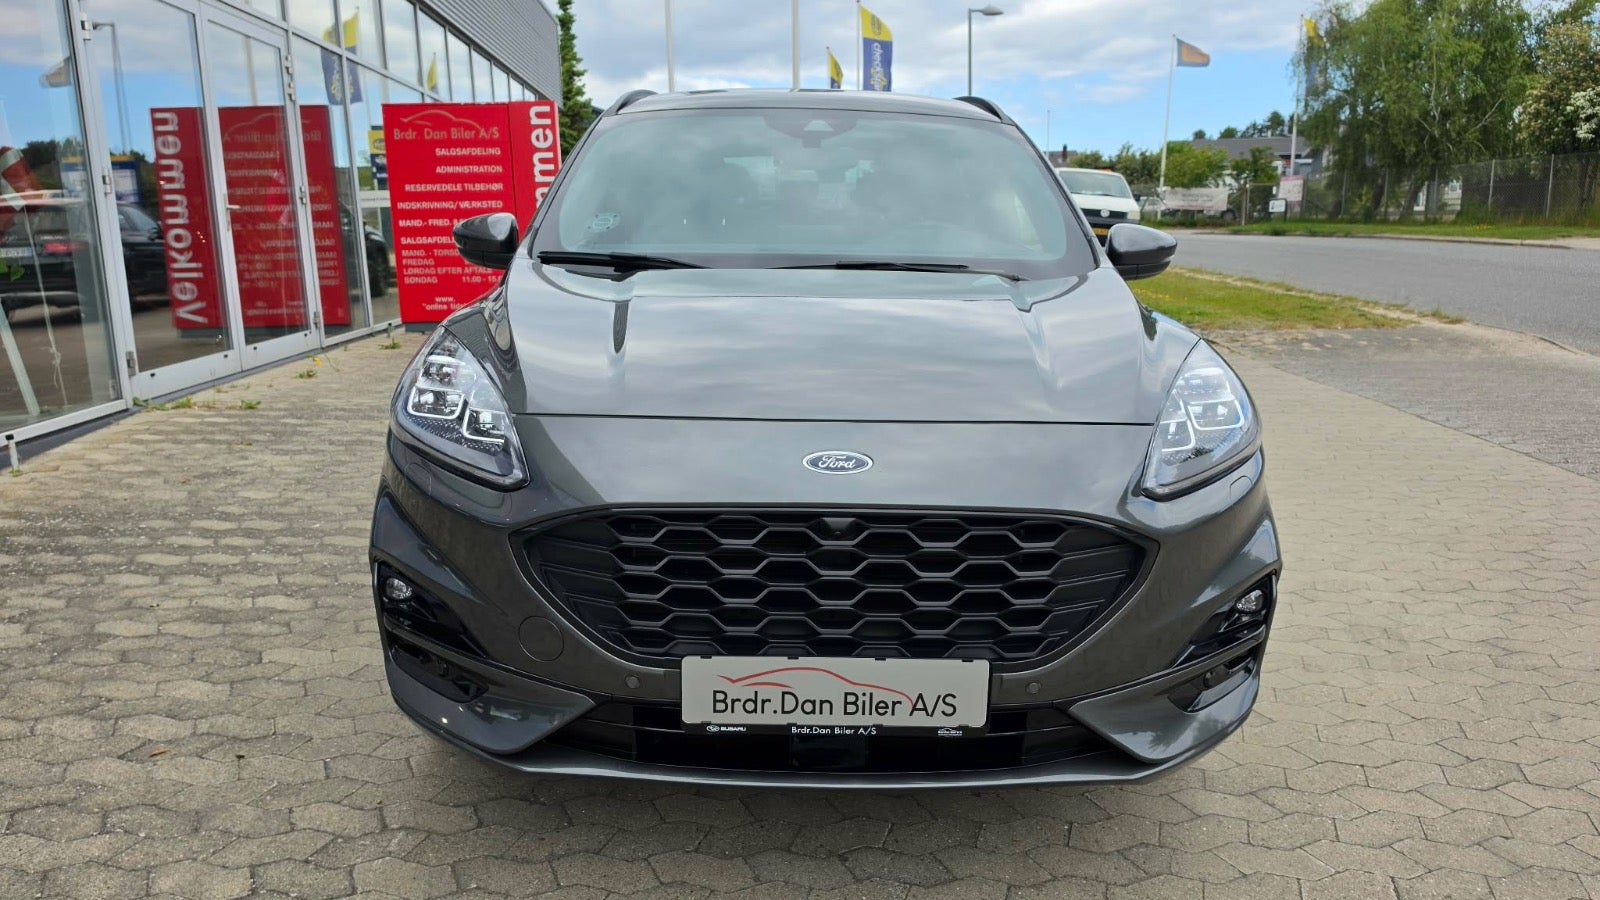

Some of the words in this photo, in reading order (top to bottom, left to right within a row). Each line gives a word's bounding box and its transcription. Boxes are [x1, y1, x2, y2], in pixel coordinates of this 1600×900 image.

[424, 128, 447, 139] Dan
[451, 127, 475, 139] Biler
[478, 127, 500, 139] A/S
[435, 147, 501, 156] SALGSAFDELING
[435, 165, 503, 174] ADMINISTRATION
[405, 183, 462, 192] RESERVEDELE
[464, 182, 504, 192] TILBEHØR
[459, 199, 503, 209] VÆRKSTED
[402, 258, 435, 266] FREDAG
[403, 267, 436, 275] LØRDAG
[404, 276, 438, 284] SØNDAG
[818, 455, 856, 468] Ford
[712, 689, 834, 715] Brdr.Dan
[843, 691, 902, 717] Biler
[909, 692, 957, 717] A/S
[834, 726, 855, 735] Biler
[857, 727, 877, 736] A/S
